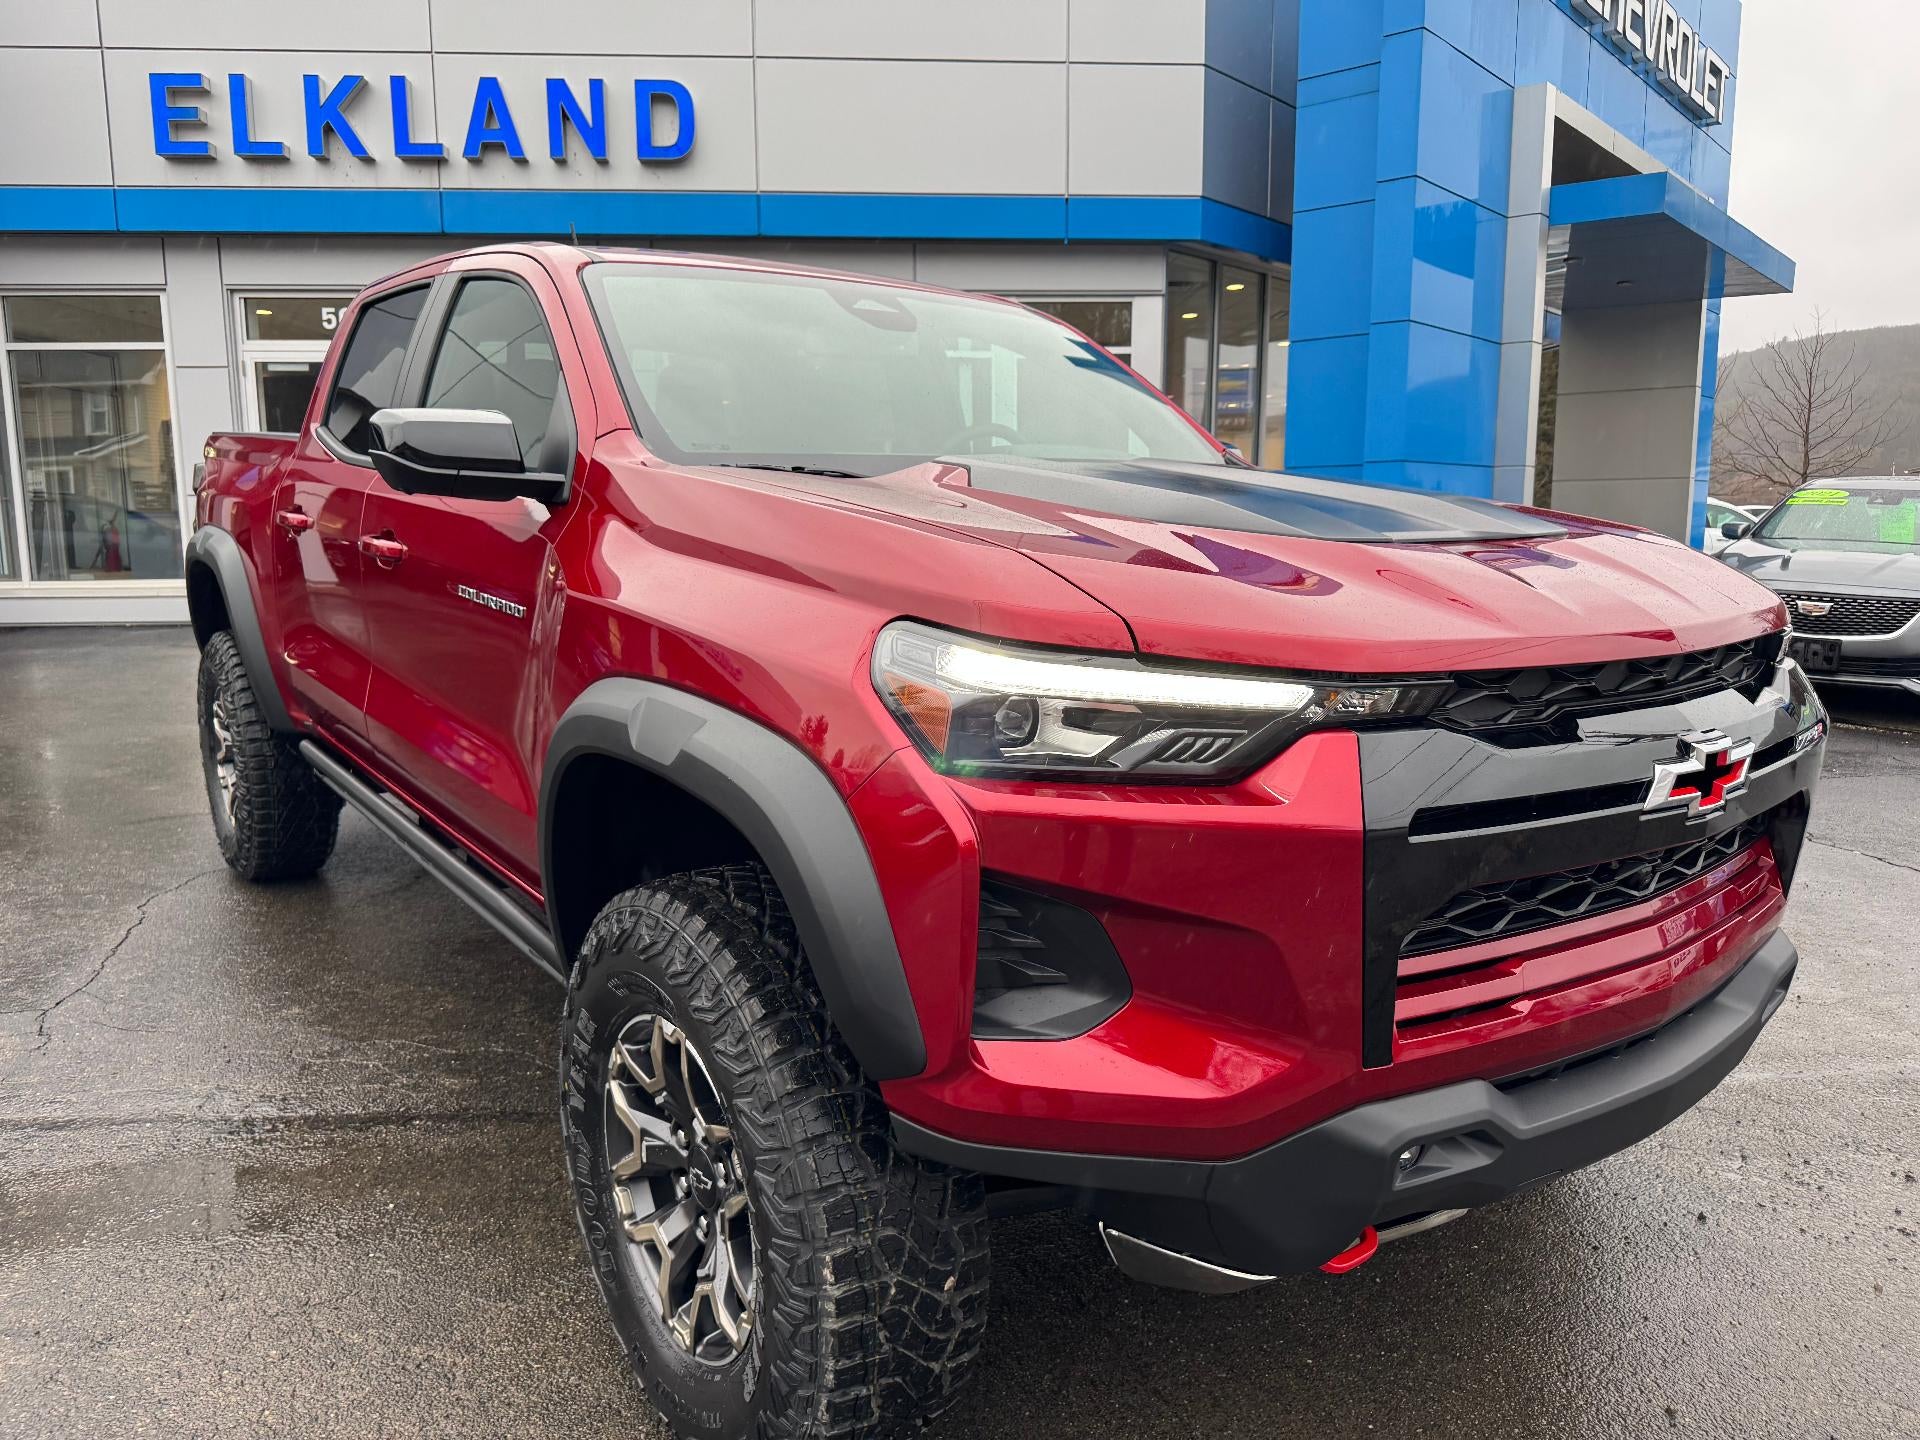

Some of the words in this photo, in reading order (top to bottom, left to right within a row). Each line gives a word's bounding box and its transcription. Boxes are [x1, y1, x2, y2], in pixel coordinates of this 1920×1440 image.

[1583, 0, 1731, 125] EVROLET
[148, 72, 697, 163] ELKLAND
[458, 584, 526, 618] COLORADO
